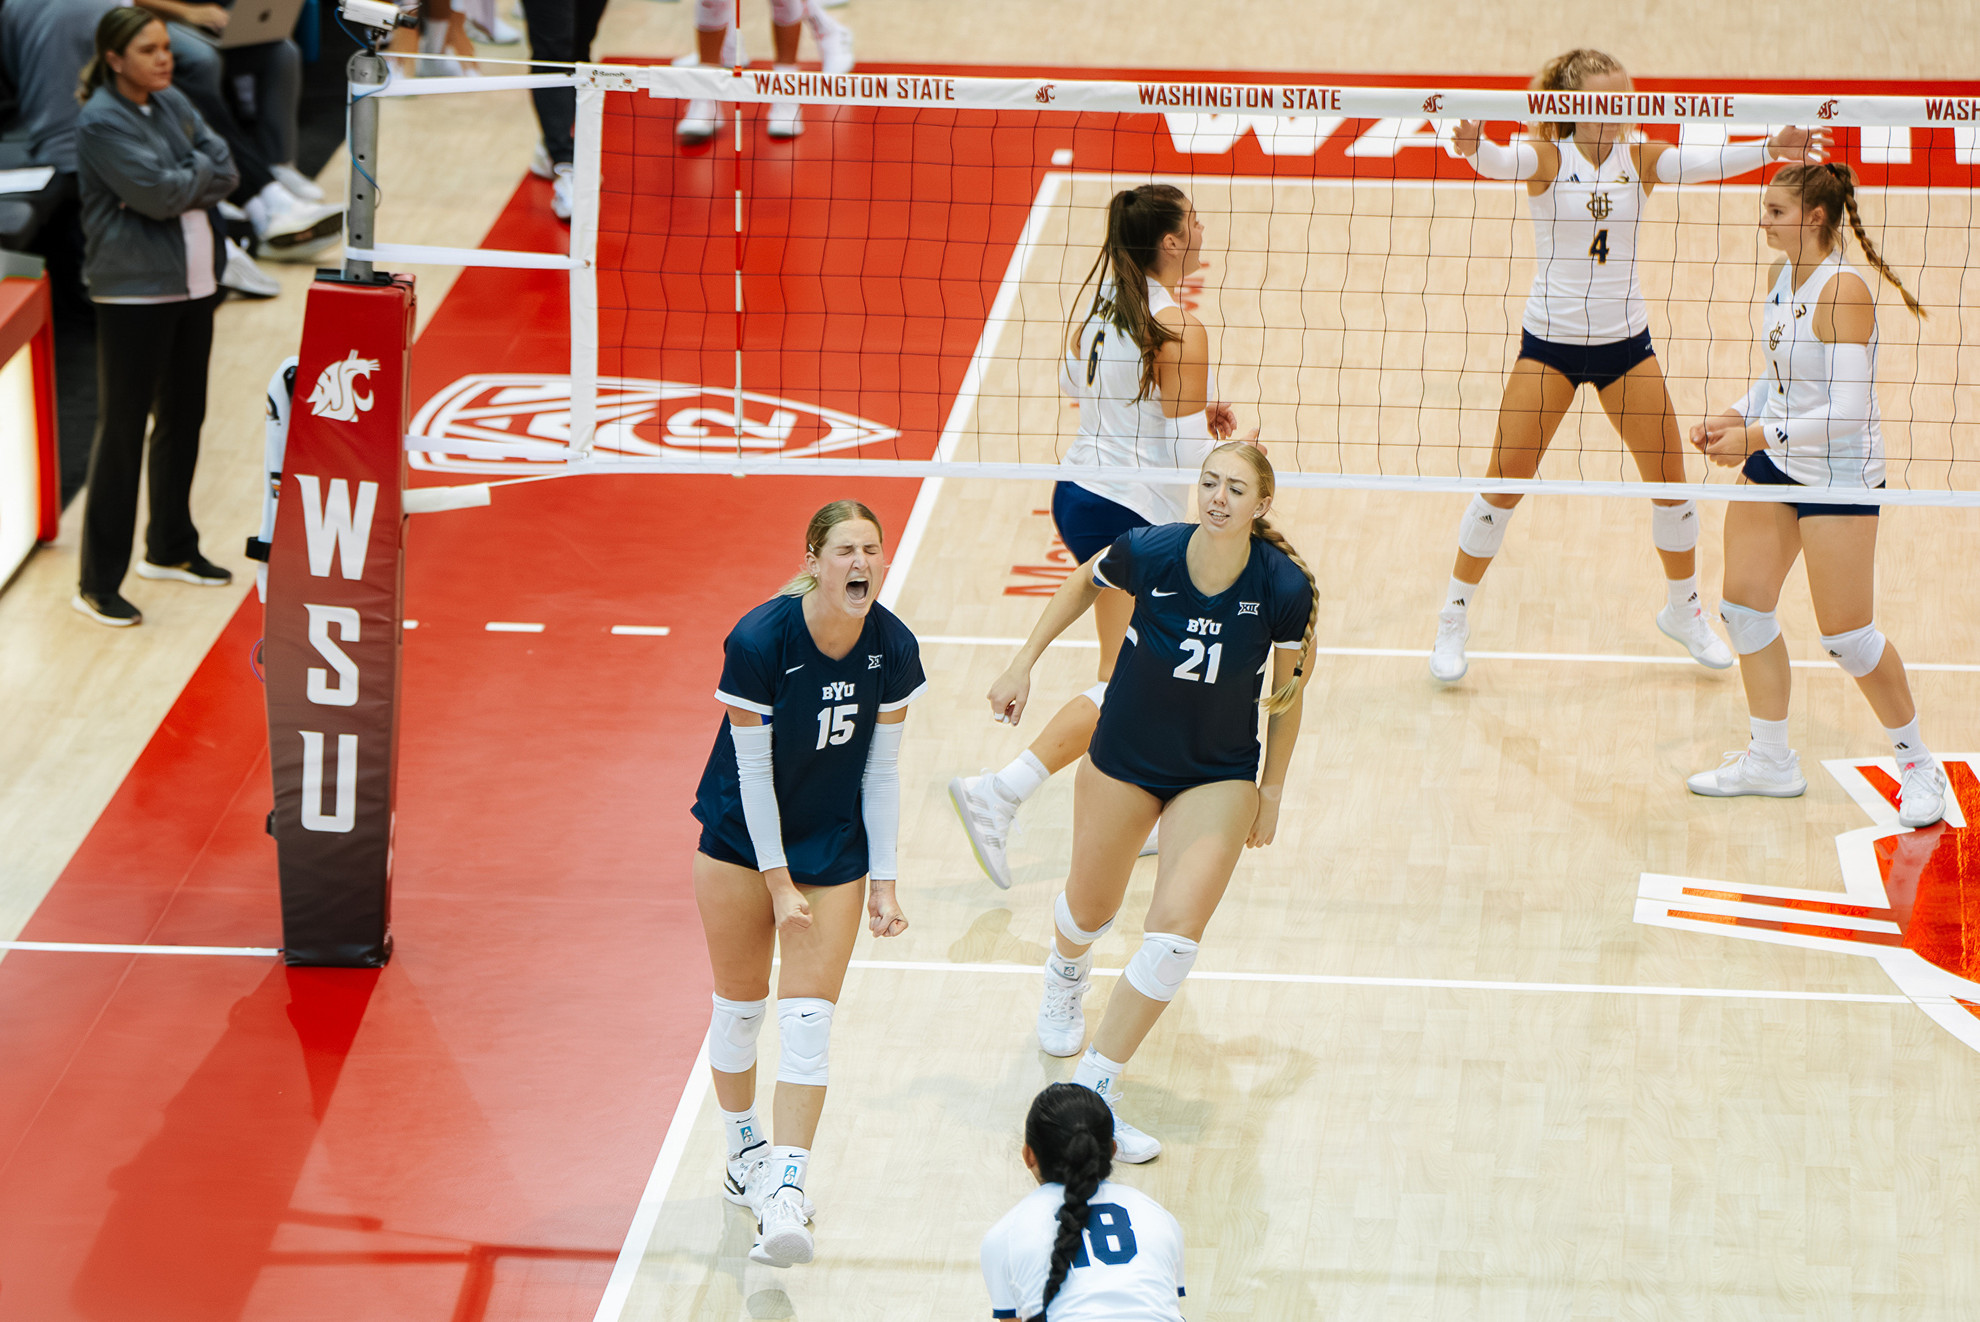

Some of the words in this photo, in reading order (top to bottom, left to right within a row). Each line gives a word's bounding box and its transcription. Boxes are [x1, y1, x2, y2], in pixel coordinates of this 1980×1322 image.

[754, 73, 888, 98] WASHINGTON
[897, 78, 955, 100] STATE
[1137, 84, 1274, 108] WASHINGTON
[1282, 88, 1342, 110] STATE
[1527, 93, 1665, 117] WASHINGTON
[1674, 95, 1735, 117] STATE
[1925, 98, 1980, 121] WASH
[1588, 228, 1610, 266] 4
[1186, 617, 1222, 636] BYU
[1172, 637, 1223, 685] 21
[822, 681, 855, 701] BYU
[816, 703, 859, 750] 15
